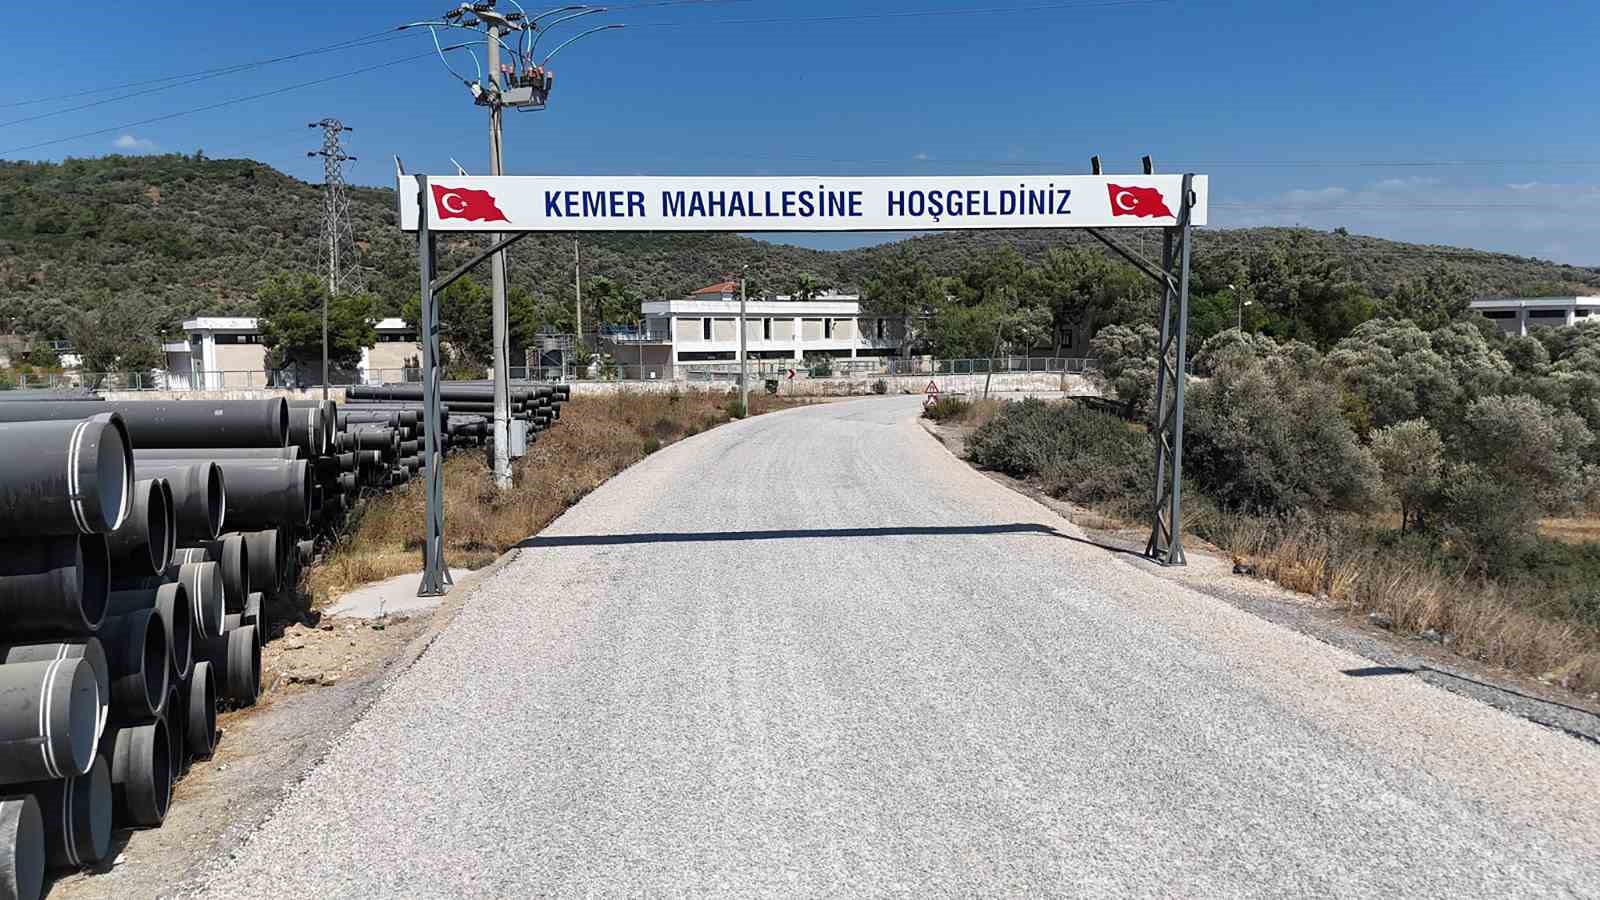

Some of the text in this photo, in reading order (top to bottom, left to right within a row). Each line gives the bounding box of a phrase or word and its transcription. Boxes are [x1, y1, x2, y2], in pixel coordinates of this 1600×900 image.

[544, 183, 1072, 222] KEMER MAHALLESİNE HOŞGELDİNİZ
